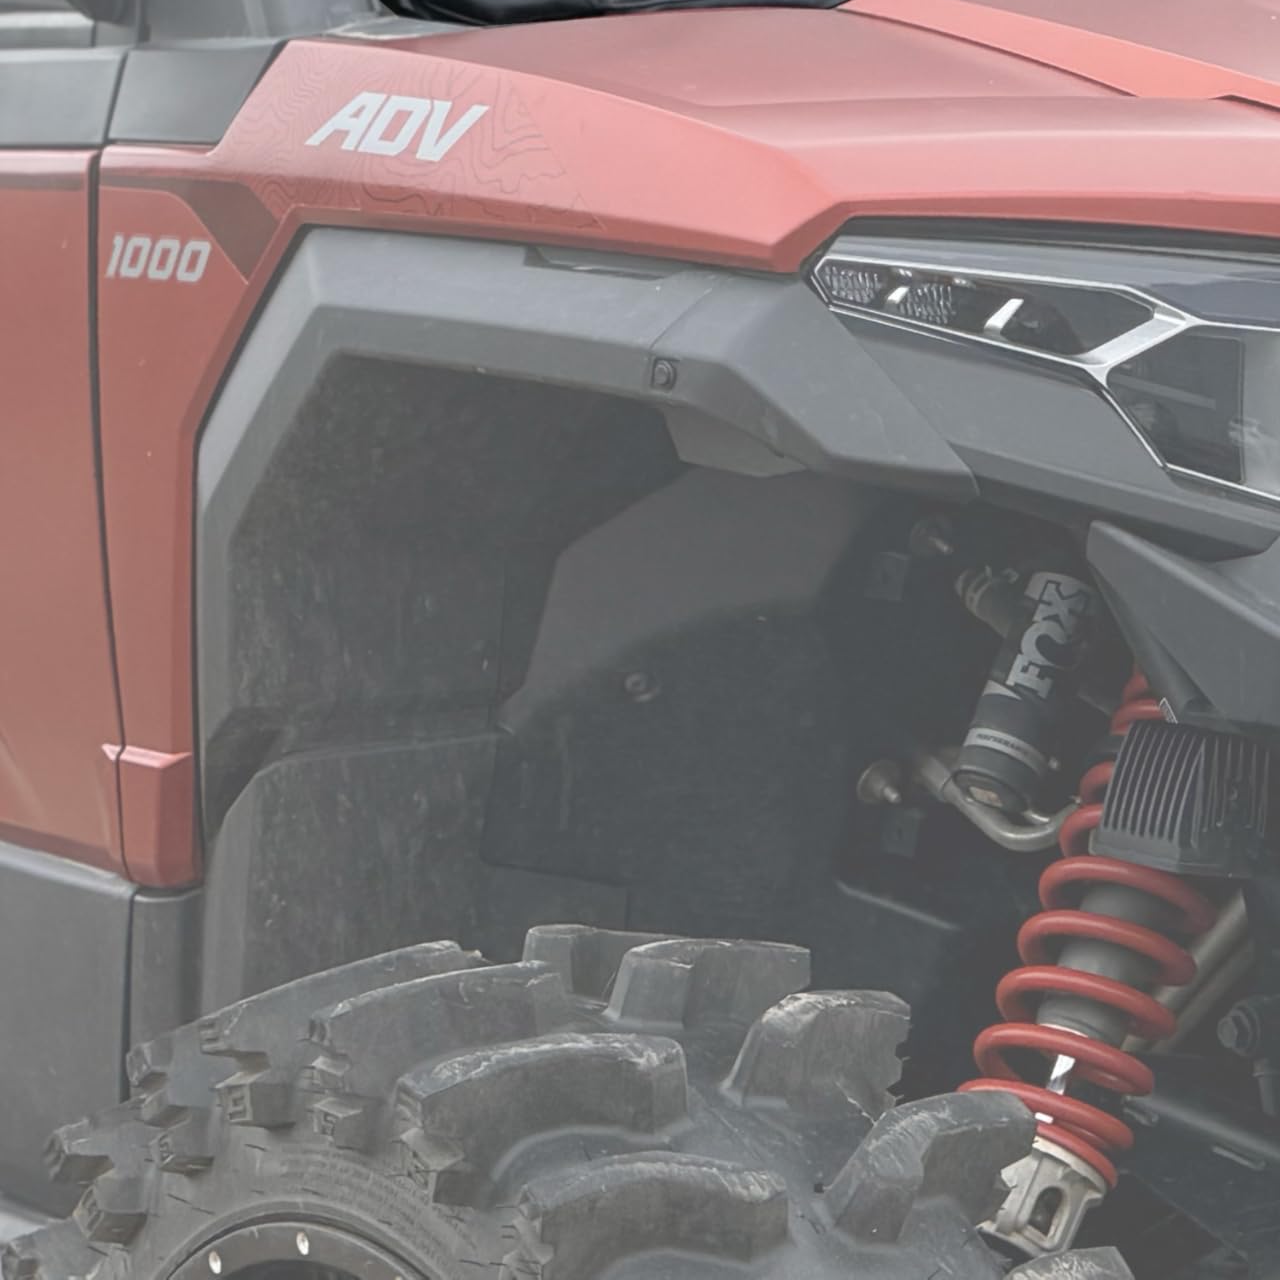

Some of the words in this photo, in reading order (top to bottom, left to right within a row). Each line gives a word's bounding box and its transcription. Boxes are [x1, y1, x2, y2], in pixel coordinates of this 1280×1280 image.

[305, 91, 490, 162] ADV
[106, 234, 211, 283] 1000
[1005, 579, 1093, 699] FOX
